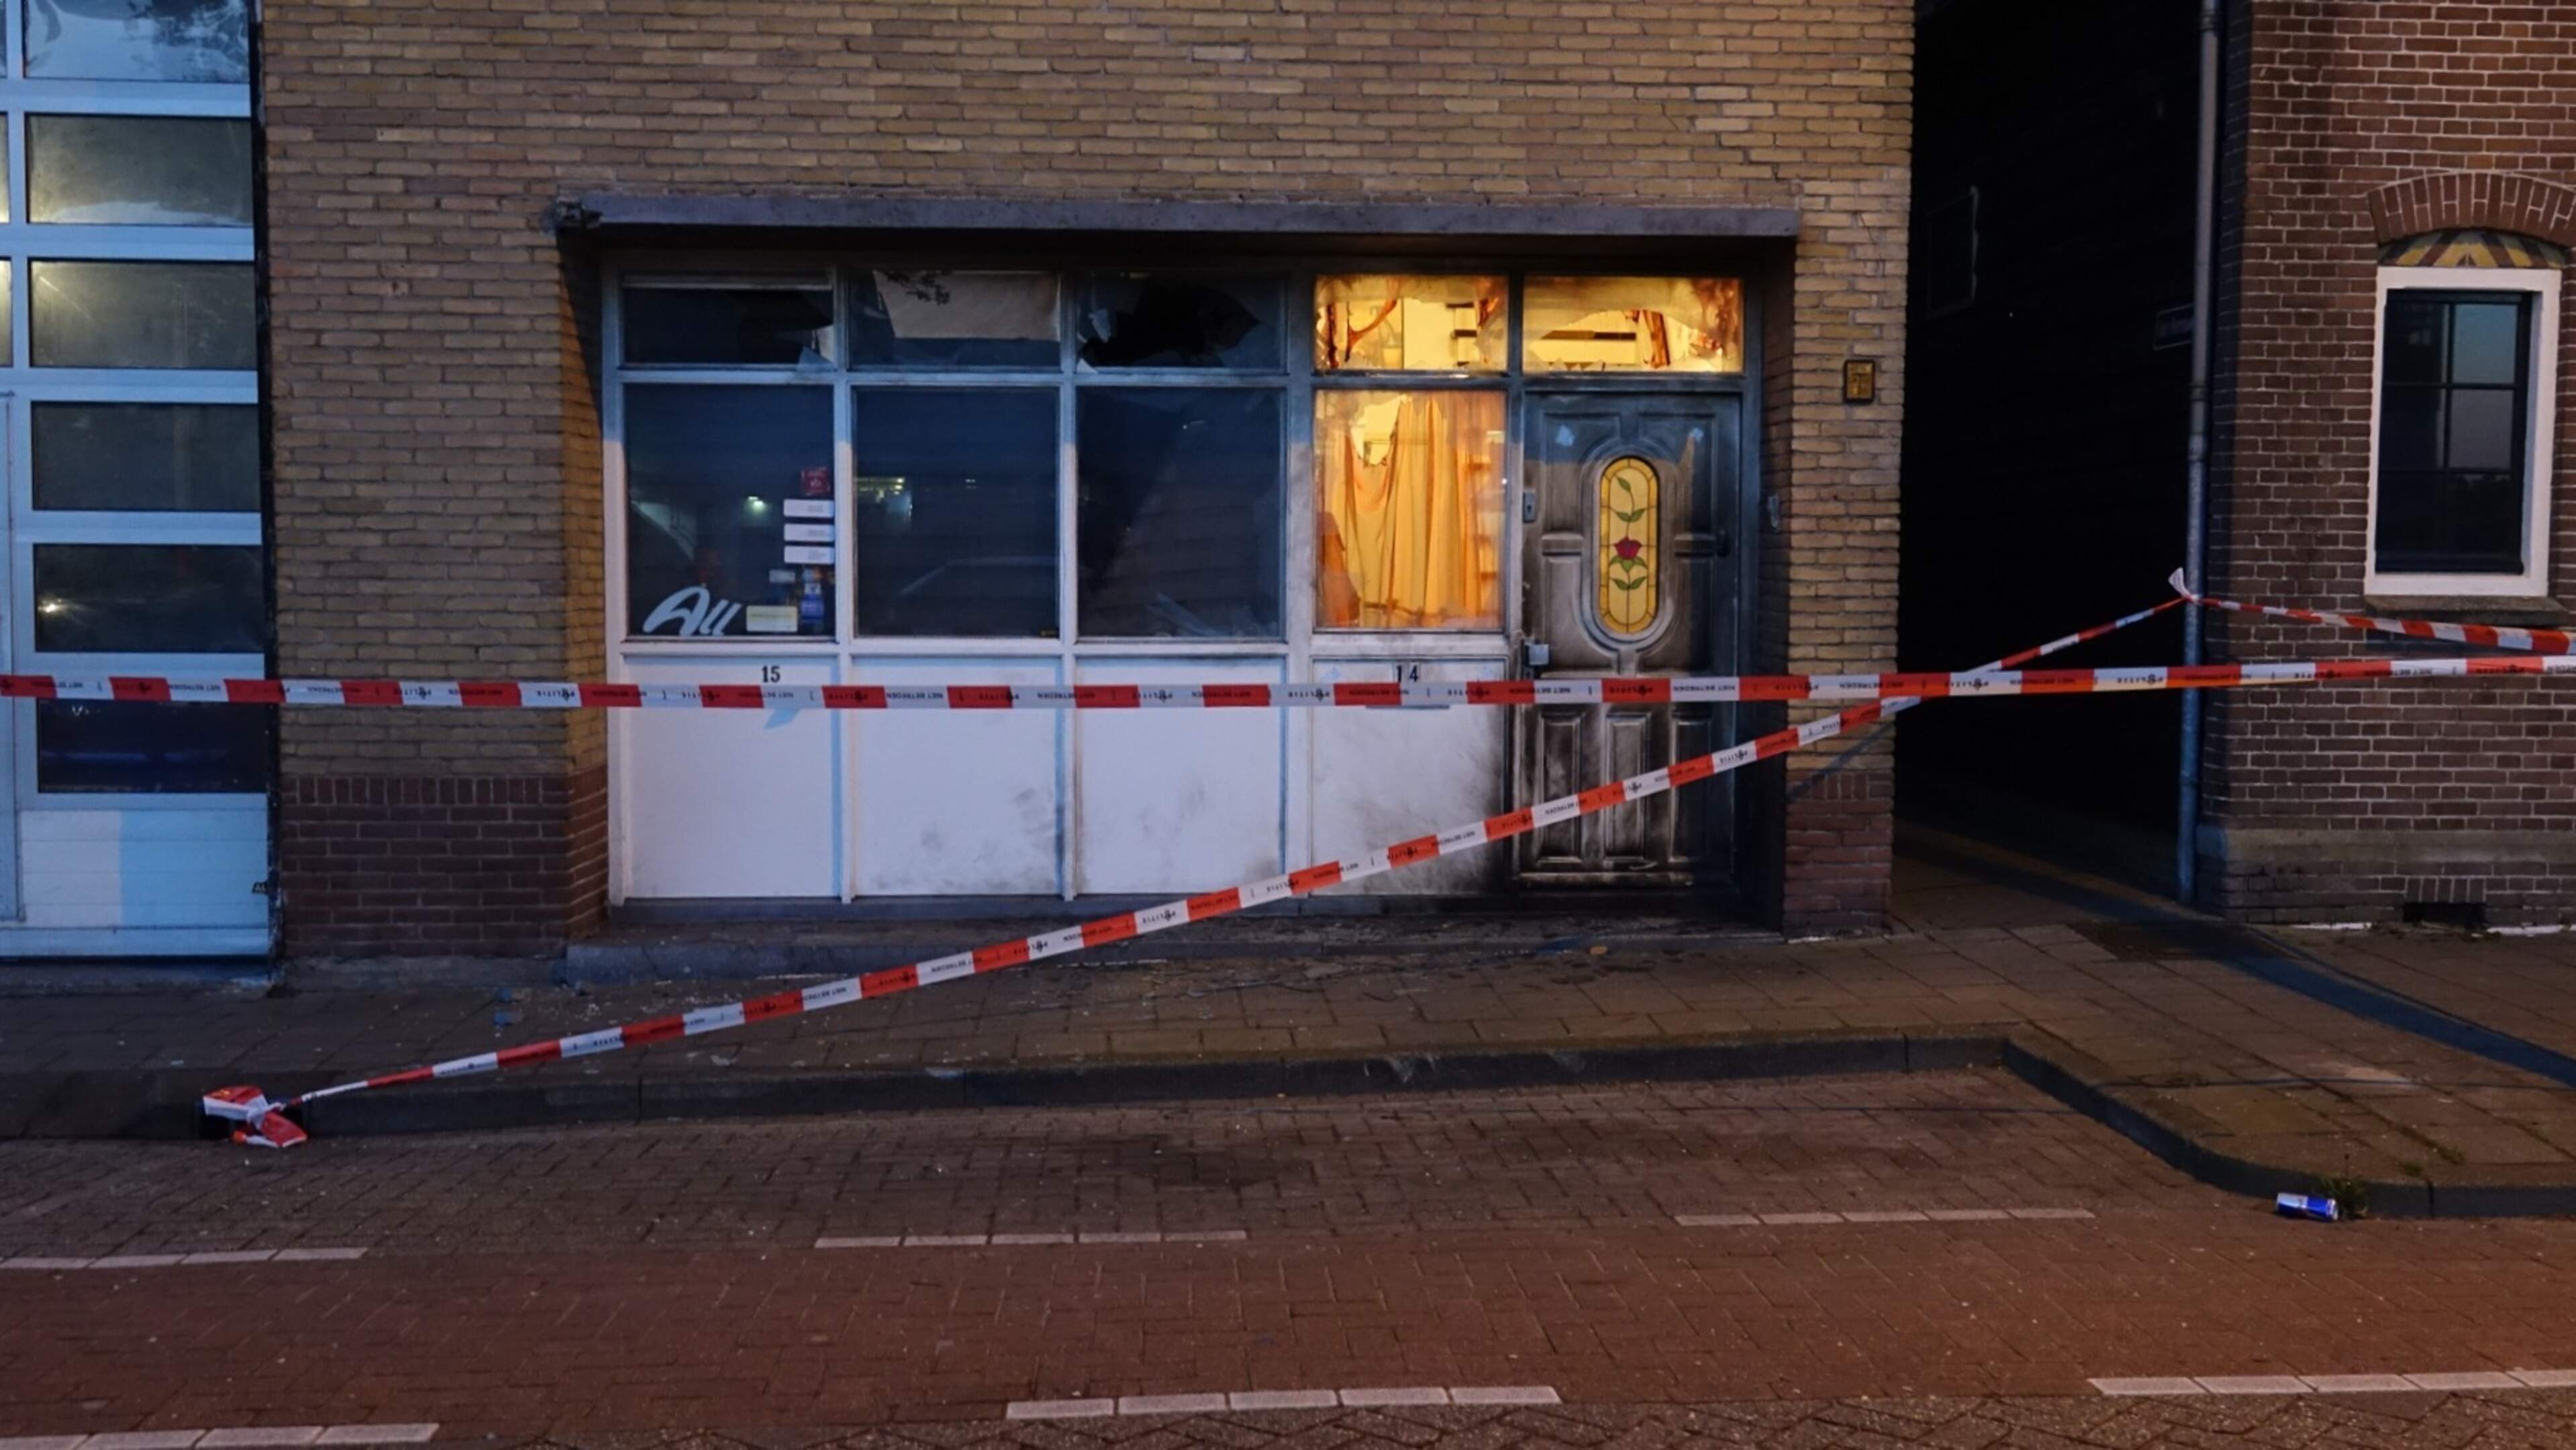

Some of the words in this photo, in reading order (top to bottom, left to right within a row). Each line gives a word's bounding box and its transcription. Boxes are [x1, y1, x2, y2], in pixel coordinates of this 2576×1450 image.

[642, 585, 742, 636] All
[762, 665, 781, 683] 15
[1396, 665, 1418, 683] 14
